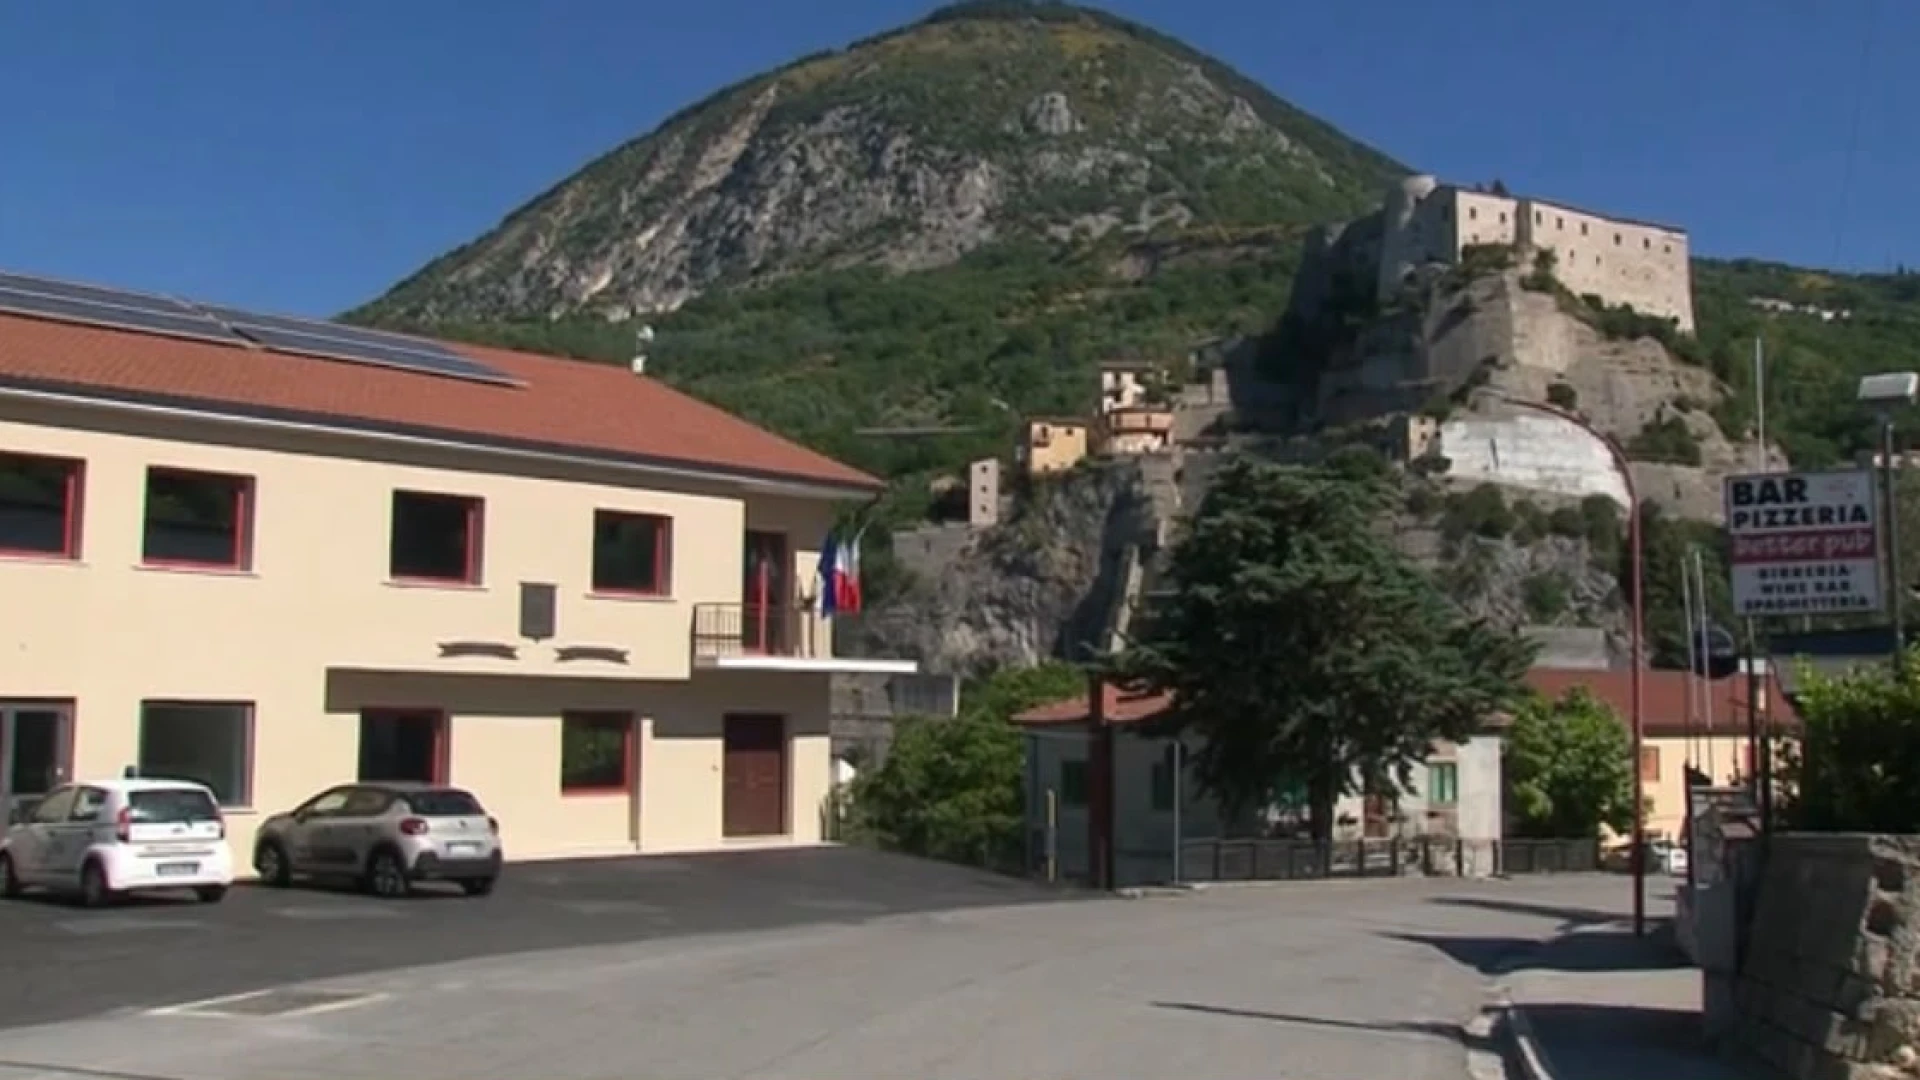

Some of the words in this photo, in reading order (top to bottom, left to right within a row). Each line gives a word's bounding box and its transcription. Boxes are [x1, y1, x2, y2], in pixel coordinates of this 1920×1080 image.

[1733, 478, 1808, 505] BAR
[1733, 505, 1868, 528] PIZZERIA
[1815, 580, 1850, 592] BAR
